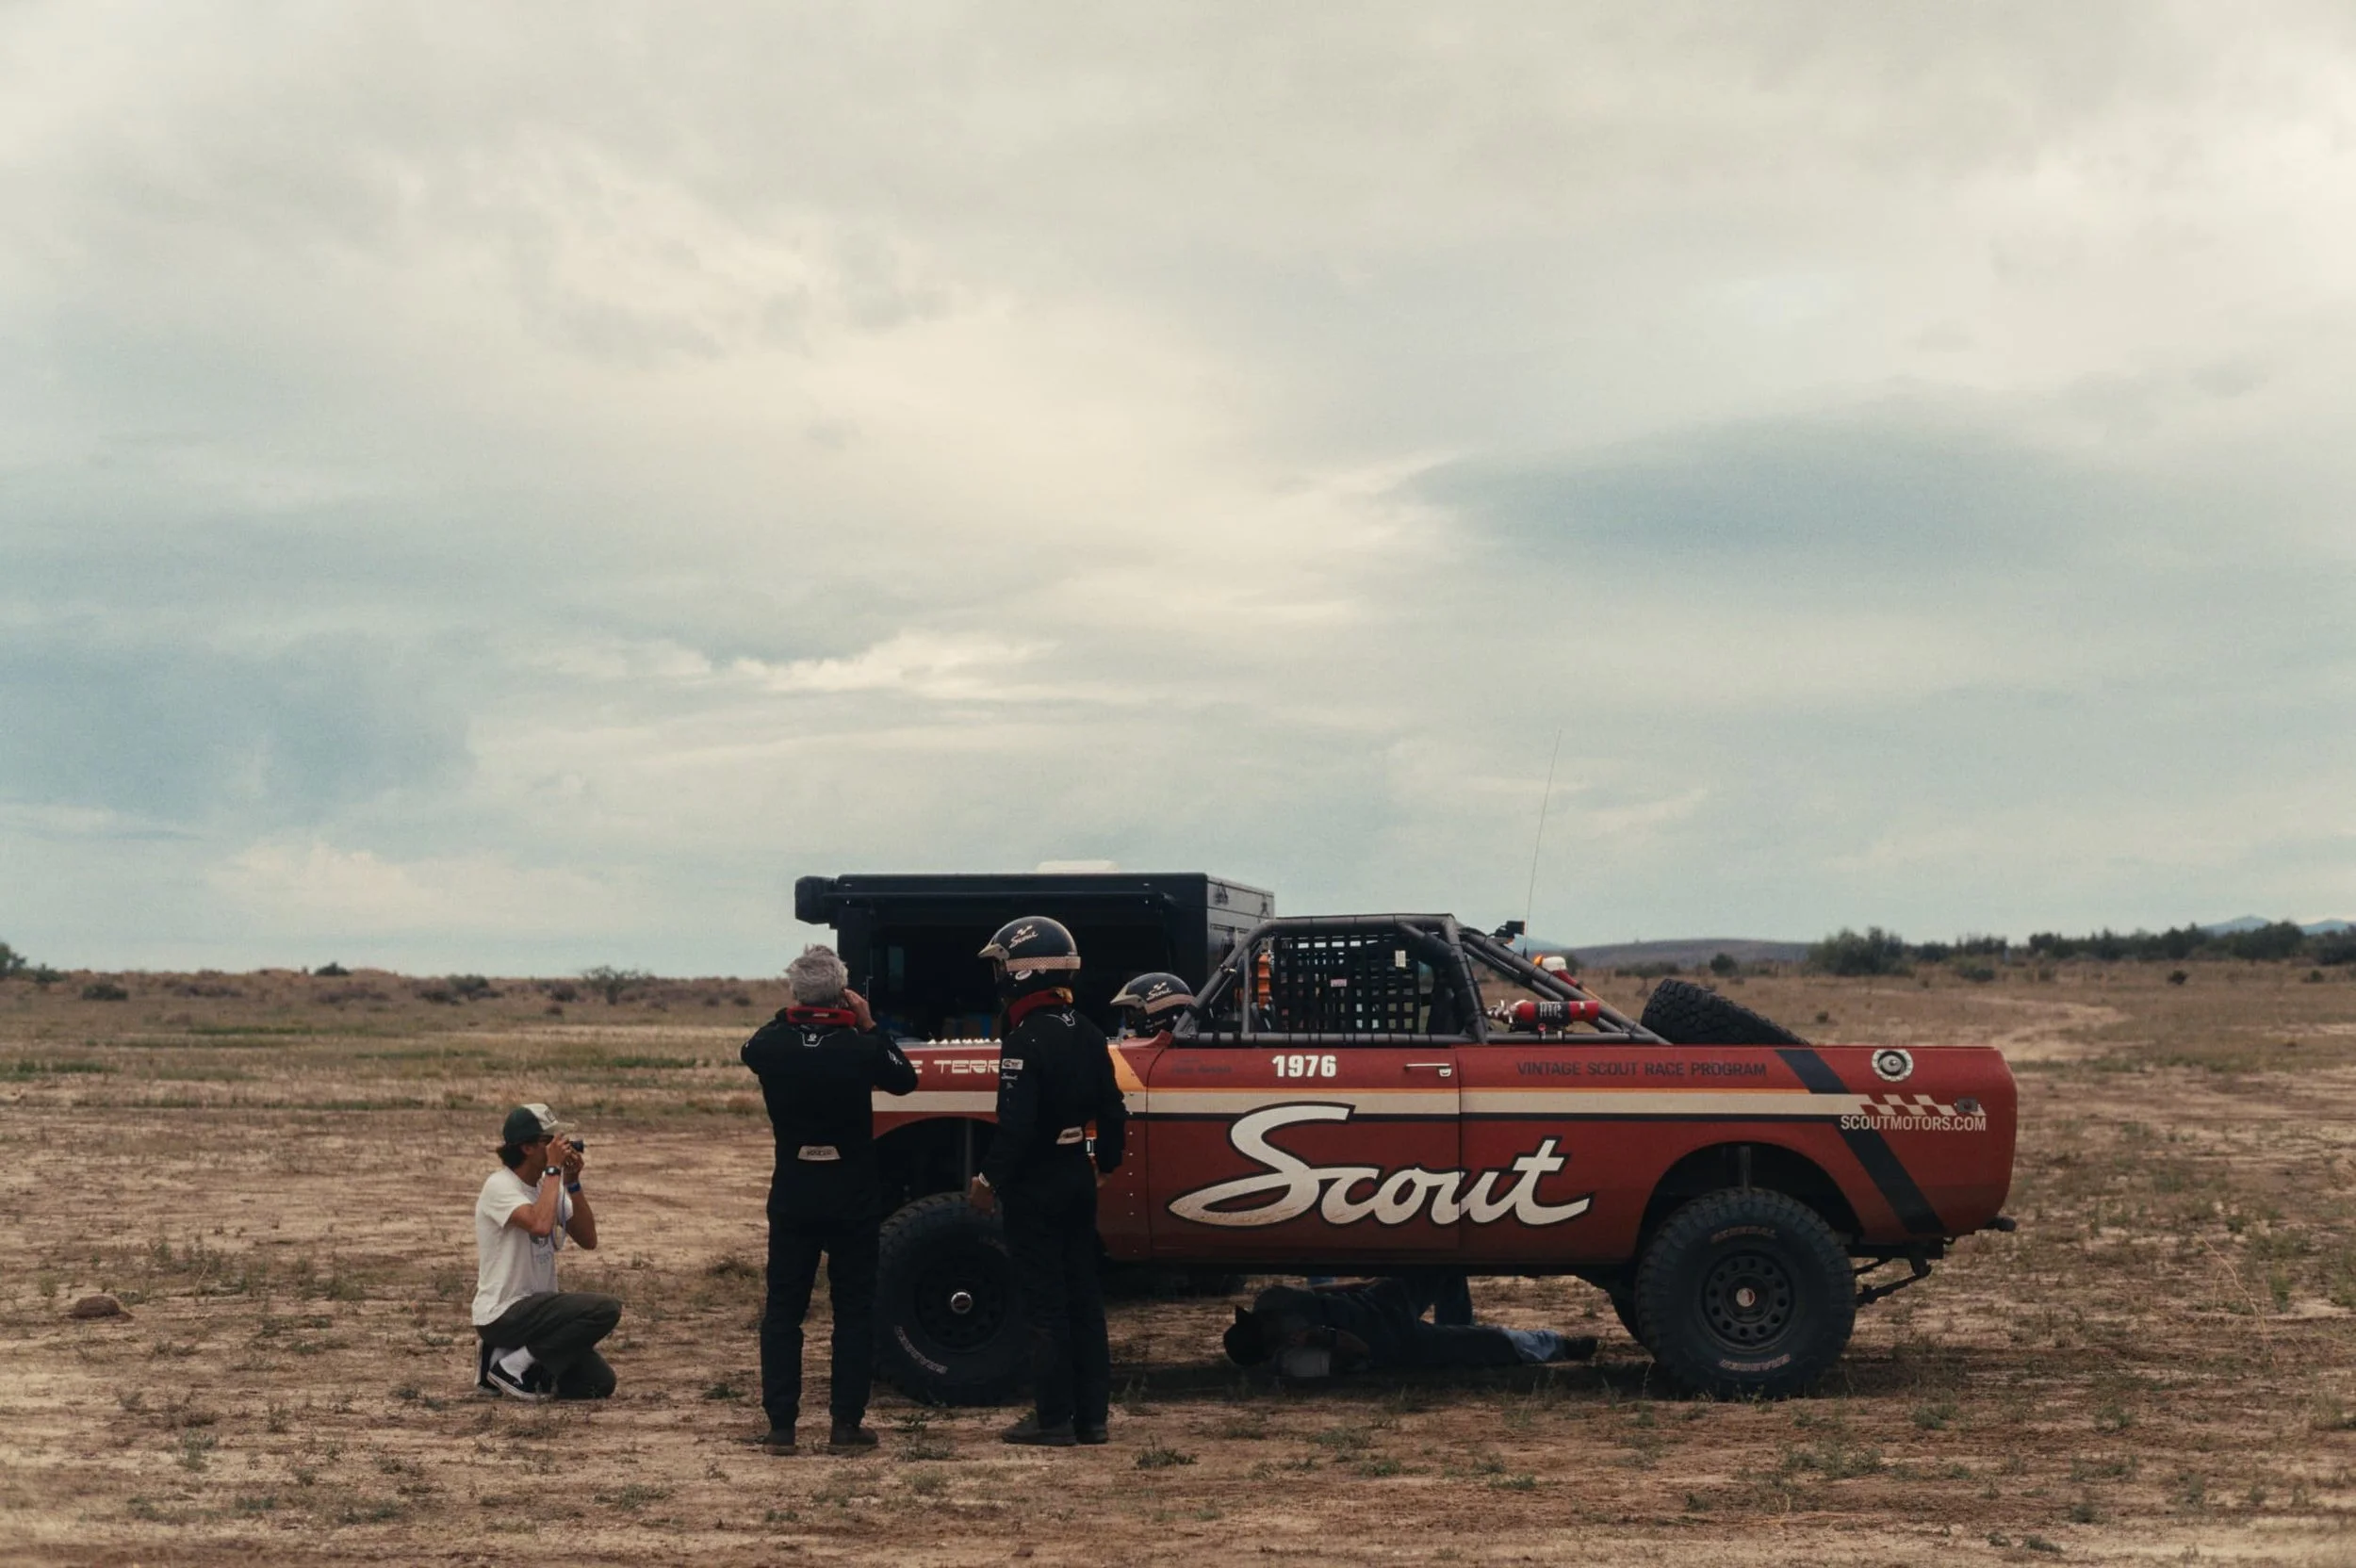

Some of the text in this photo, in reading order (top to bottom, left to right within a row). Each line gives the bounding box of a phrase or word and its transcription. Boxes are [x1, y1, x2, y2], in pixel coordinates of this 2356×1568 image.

[1272, 1054, 1336, 1077] 1976
[1516, 1061, 1767, 1076] VINTAGE SCOUT RACE PROGRAM
[1841, 1115, 1987, 1131] SCOUTMOTORS.COM
[1168, 1103, 1592, 1227] Scout
